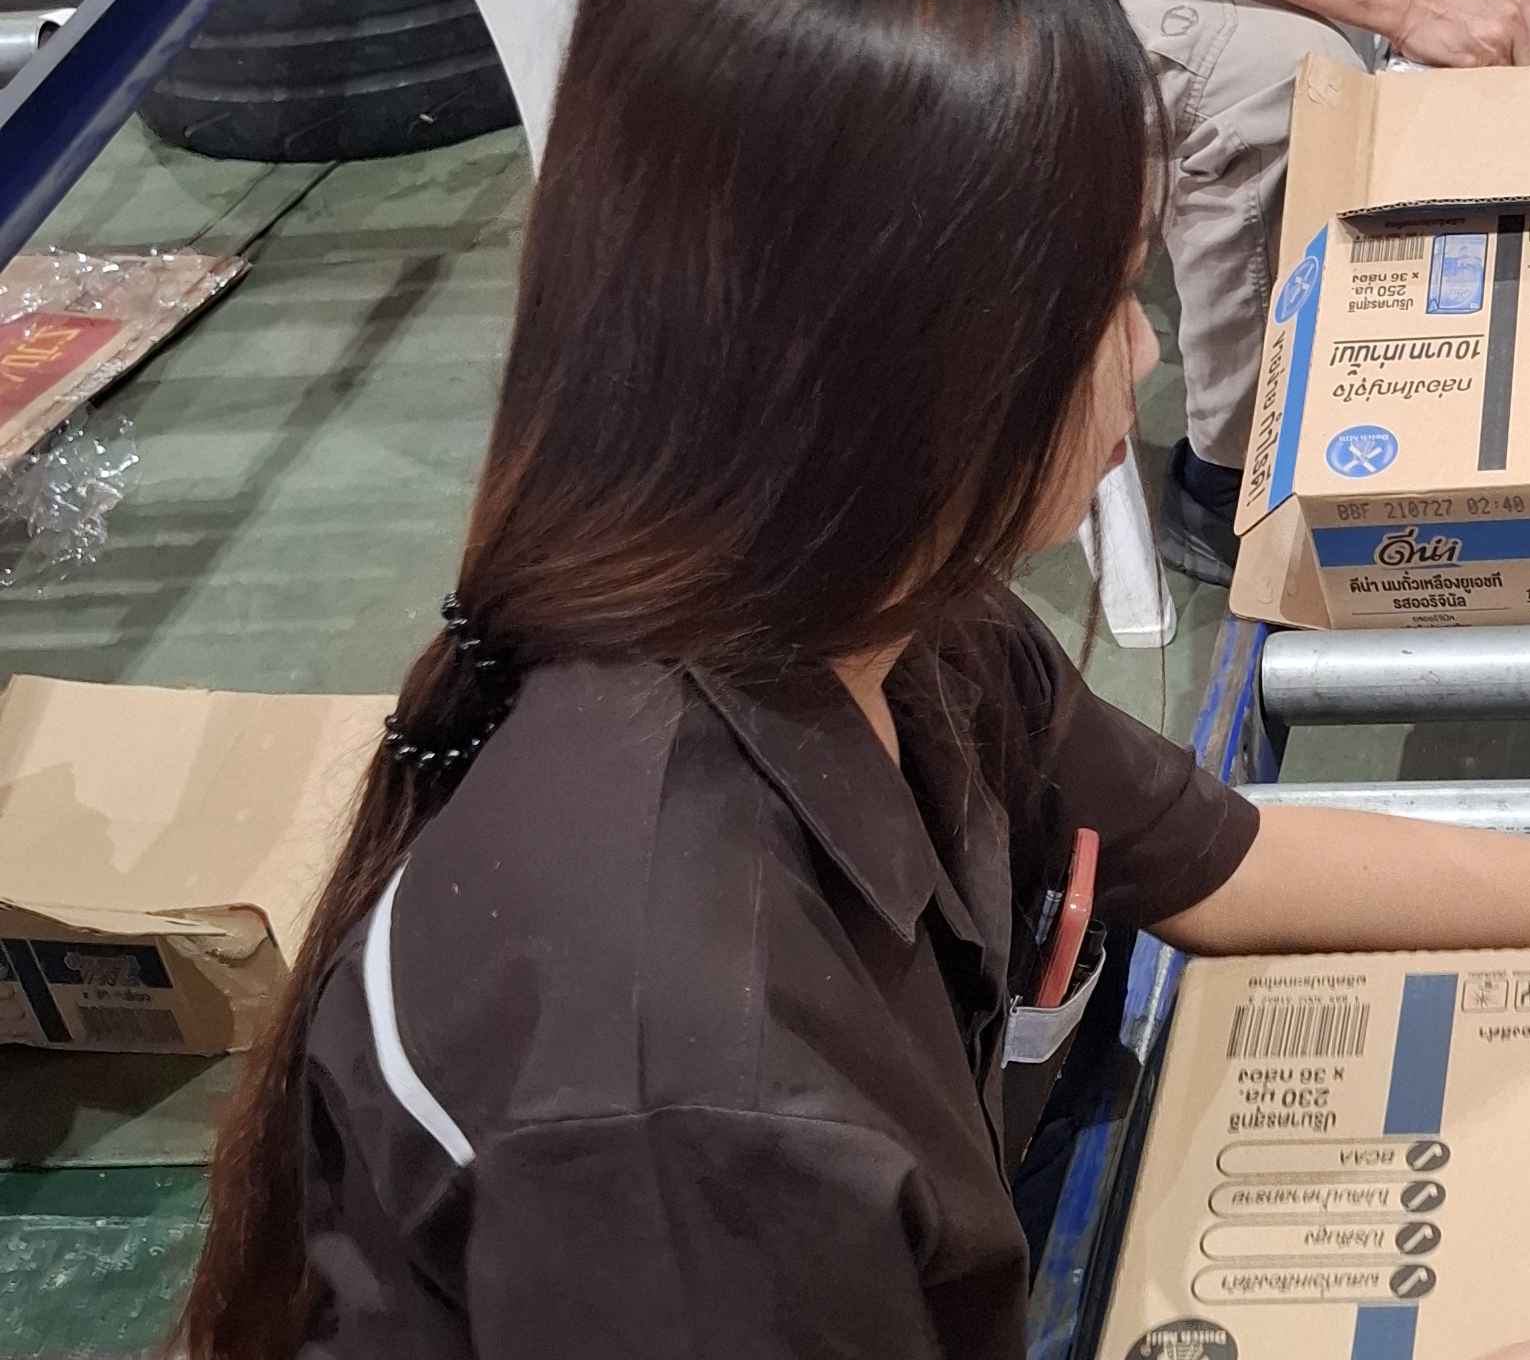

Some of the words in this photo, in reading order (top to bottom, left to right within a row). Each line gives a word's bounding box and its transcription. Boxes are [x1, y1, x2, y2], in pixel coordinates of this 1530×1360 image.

[1351, 273, 1387, 287] กล่อง
[1390, 272, 1409, 283] 36
[1377, 284, 1406, 297] 250
[1331, 376, 1473, 403] กล่องใหญ่จุใจ
[1393, 593, 1467, 610] รสออริจินัล
[1300, 1067, 1327, 1085] 36
[1281, 1087, 1330, 1109] 230
